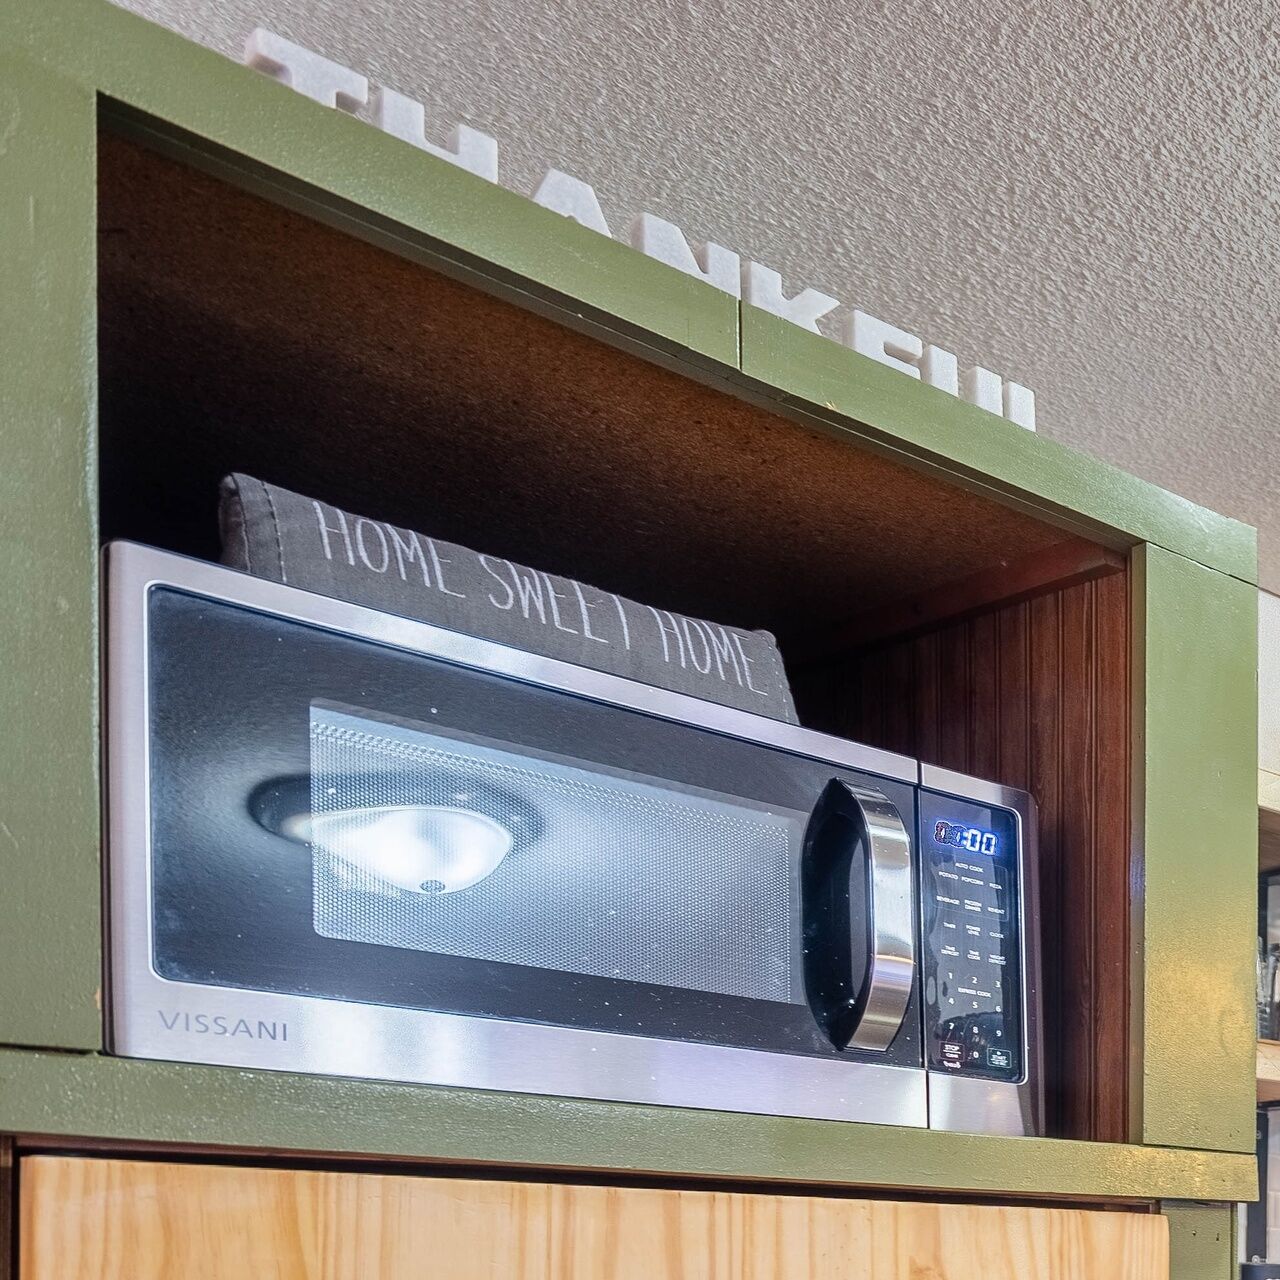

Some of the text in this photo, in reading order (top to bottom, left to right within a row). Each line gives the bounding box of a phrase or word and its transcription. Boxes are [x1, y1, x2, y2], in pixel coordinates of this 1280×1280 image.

[312, 500, 467, 598] HOME
[646, 605, 769, 696] HOME
[972, 976, 978, 984] 2
[995, 980, 1001, 988] 3
[972, 1001, 978, 1009] 5
[995, 1005, 1001, 1013] 6
[158, 1010, 288, 1042] VISSANI
[949, 1022, 955, 1030] 7
[972, 1026, 979, 1034] 8
[996, 1030, 1002, 1038] 9
